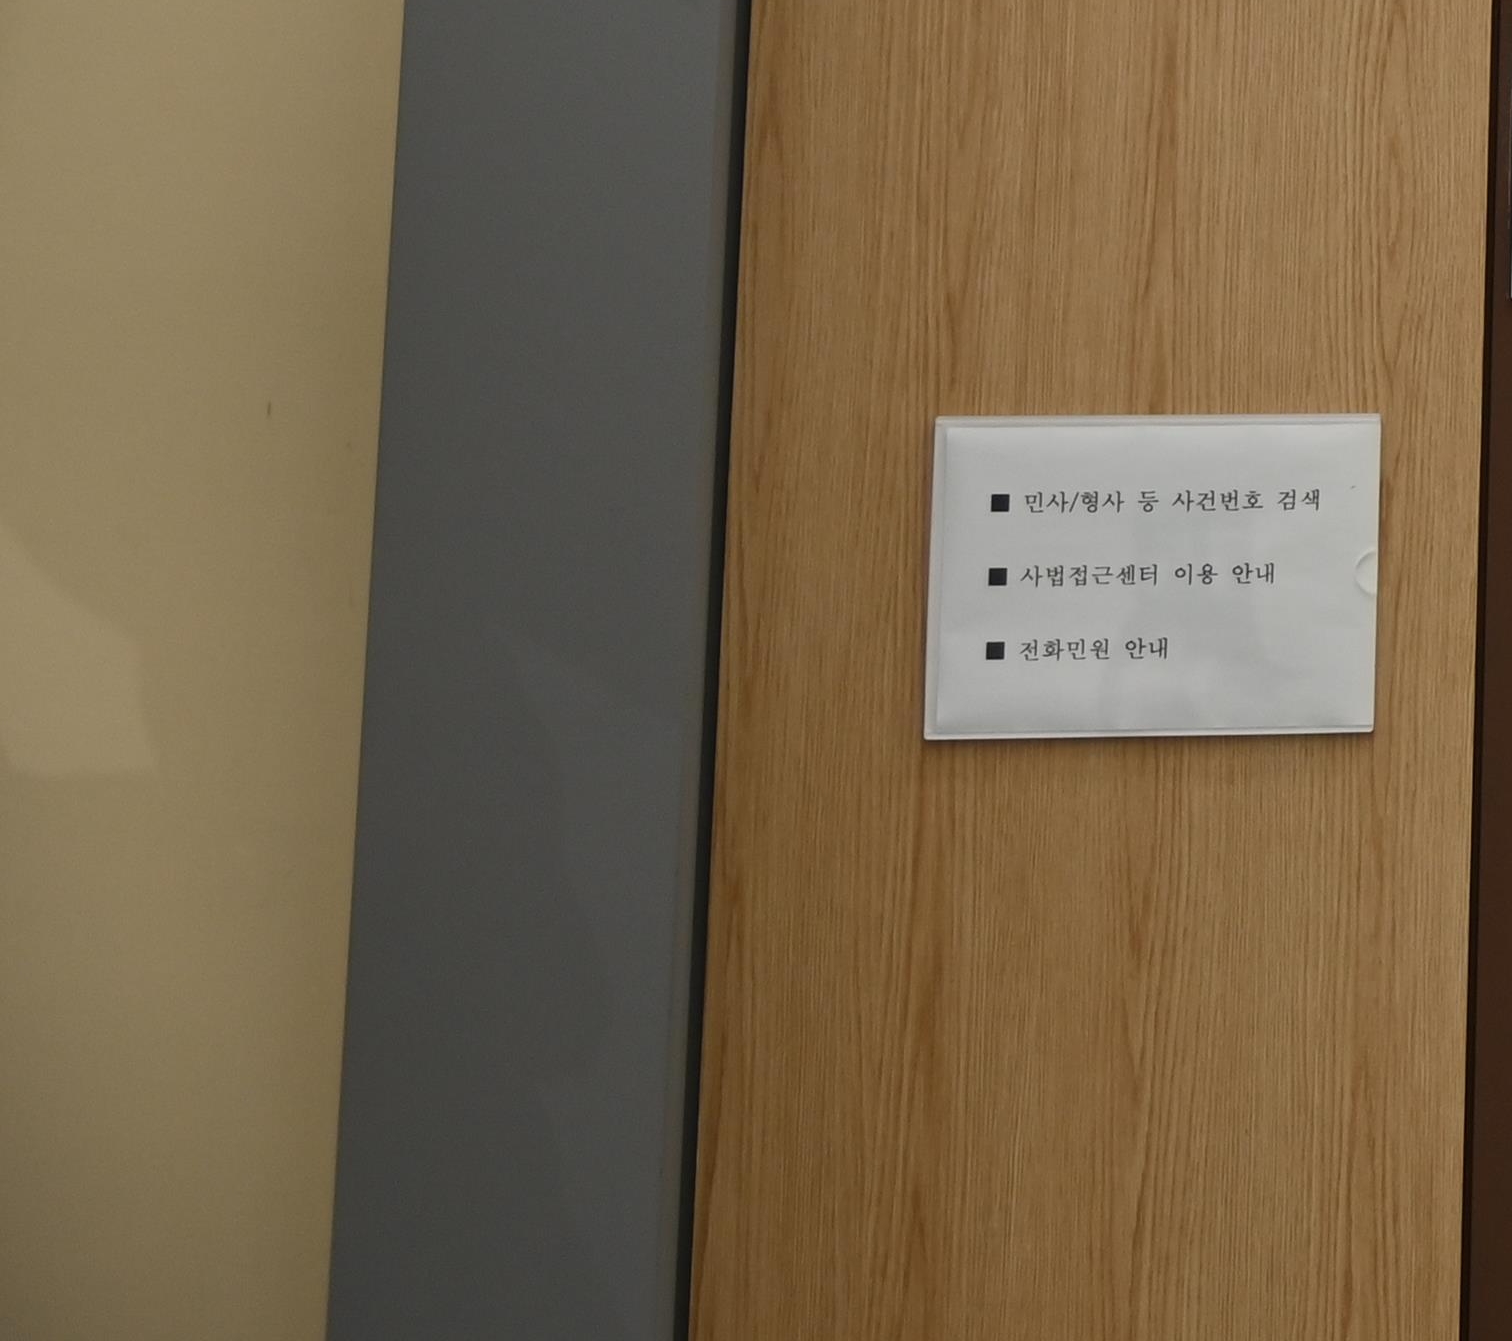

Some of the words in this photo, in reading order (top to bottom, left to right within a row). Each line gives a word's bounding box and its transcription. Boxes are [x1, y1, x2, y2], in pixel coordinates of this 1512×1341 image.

[1024, 491, 1125, 514] 민사/형사
[1138, 491, 1159, 513] 등
[1172, 490, 1263, 512] 사건번호
[1277, 489, 1321, 511] 검색
[1020, 564, 1159, 587] 사법접근센터
[1174, 564, 1218, 585] 이용
[1232, 563, 1276, 585] 안내
[1020, 639, 1111, 661] 전화민원
[1125, 638, 1169, 660] 안내
